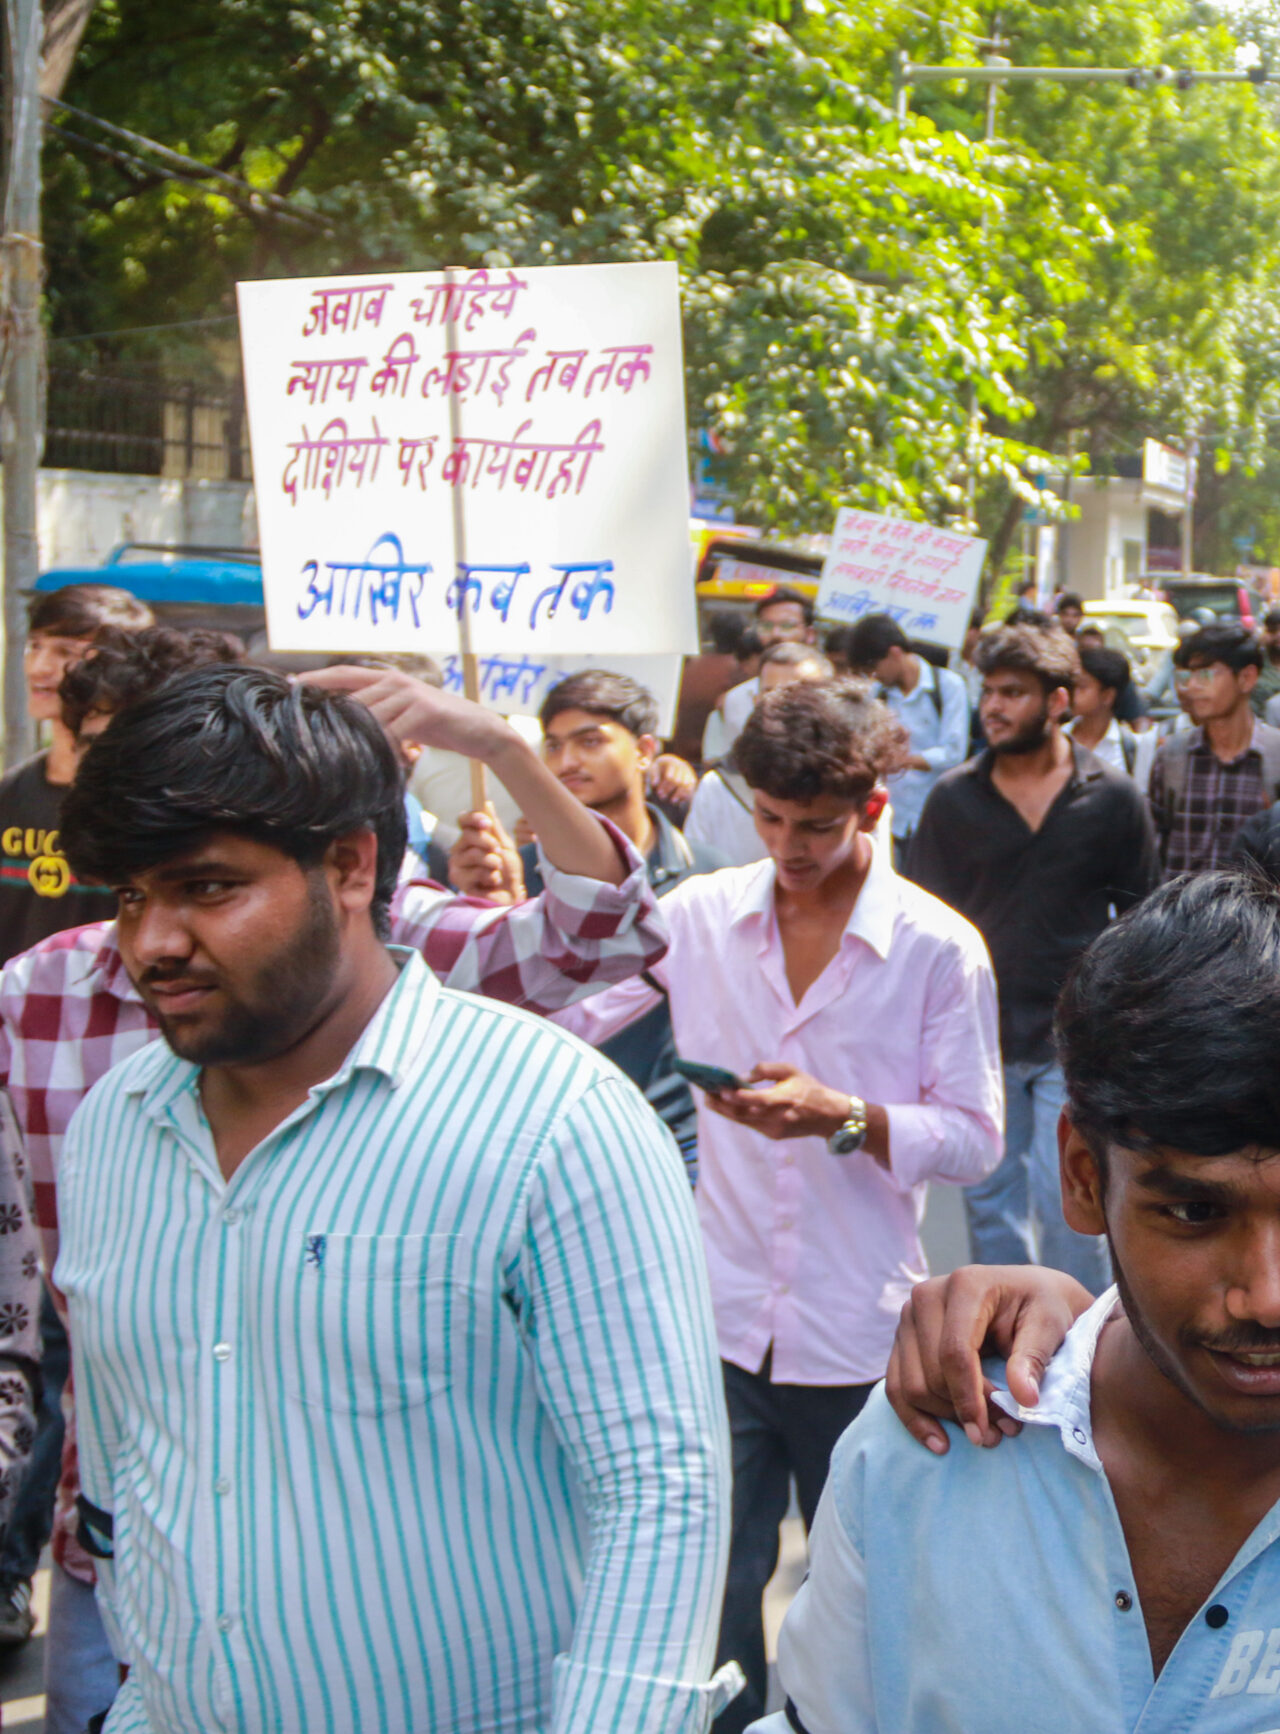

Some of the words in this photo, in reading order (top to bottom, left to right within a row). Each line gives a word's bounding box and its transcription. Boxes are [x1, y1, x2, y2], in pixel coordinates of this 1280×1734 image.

[409, 268, 528, 332] चाहिये
[286, 356, 369, 405] न्याय
[370, 332, 420, 398] की
[526, 349, 589, 403] तब
[582, 344, 653, 399] तक
[397, 434, 440, 491] पर
[442, 417, 605, 499] कार्यवाही
[298, 531, 433, 628] आखिर
[446, 561, 531, 622] कब
[529, 559, 615, 630] तक
